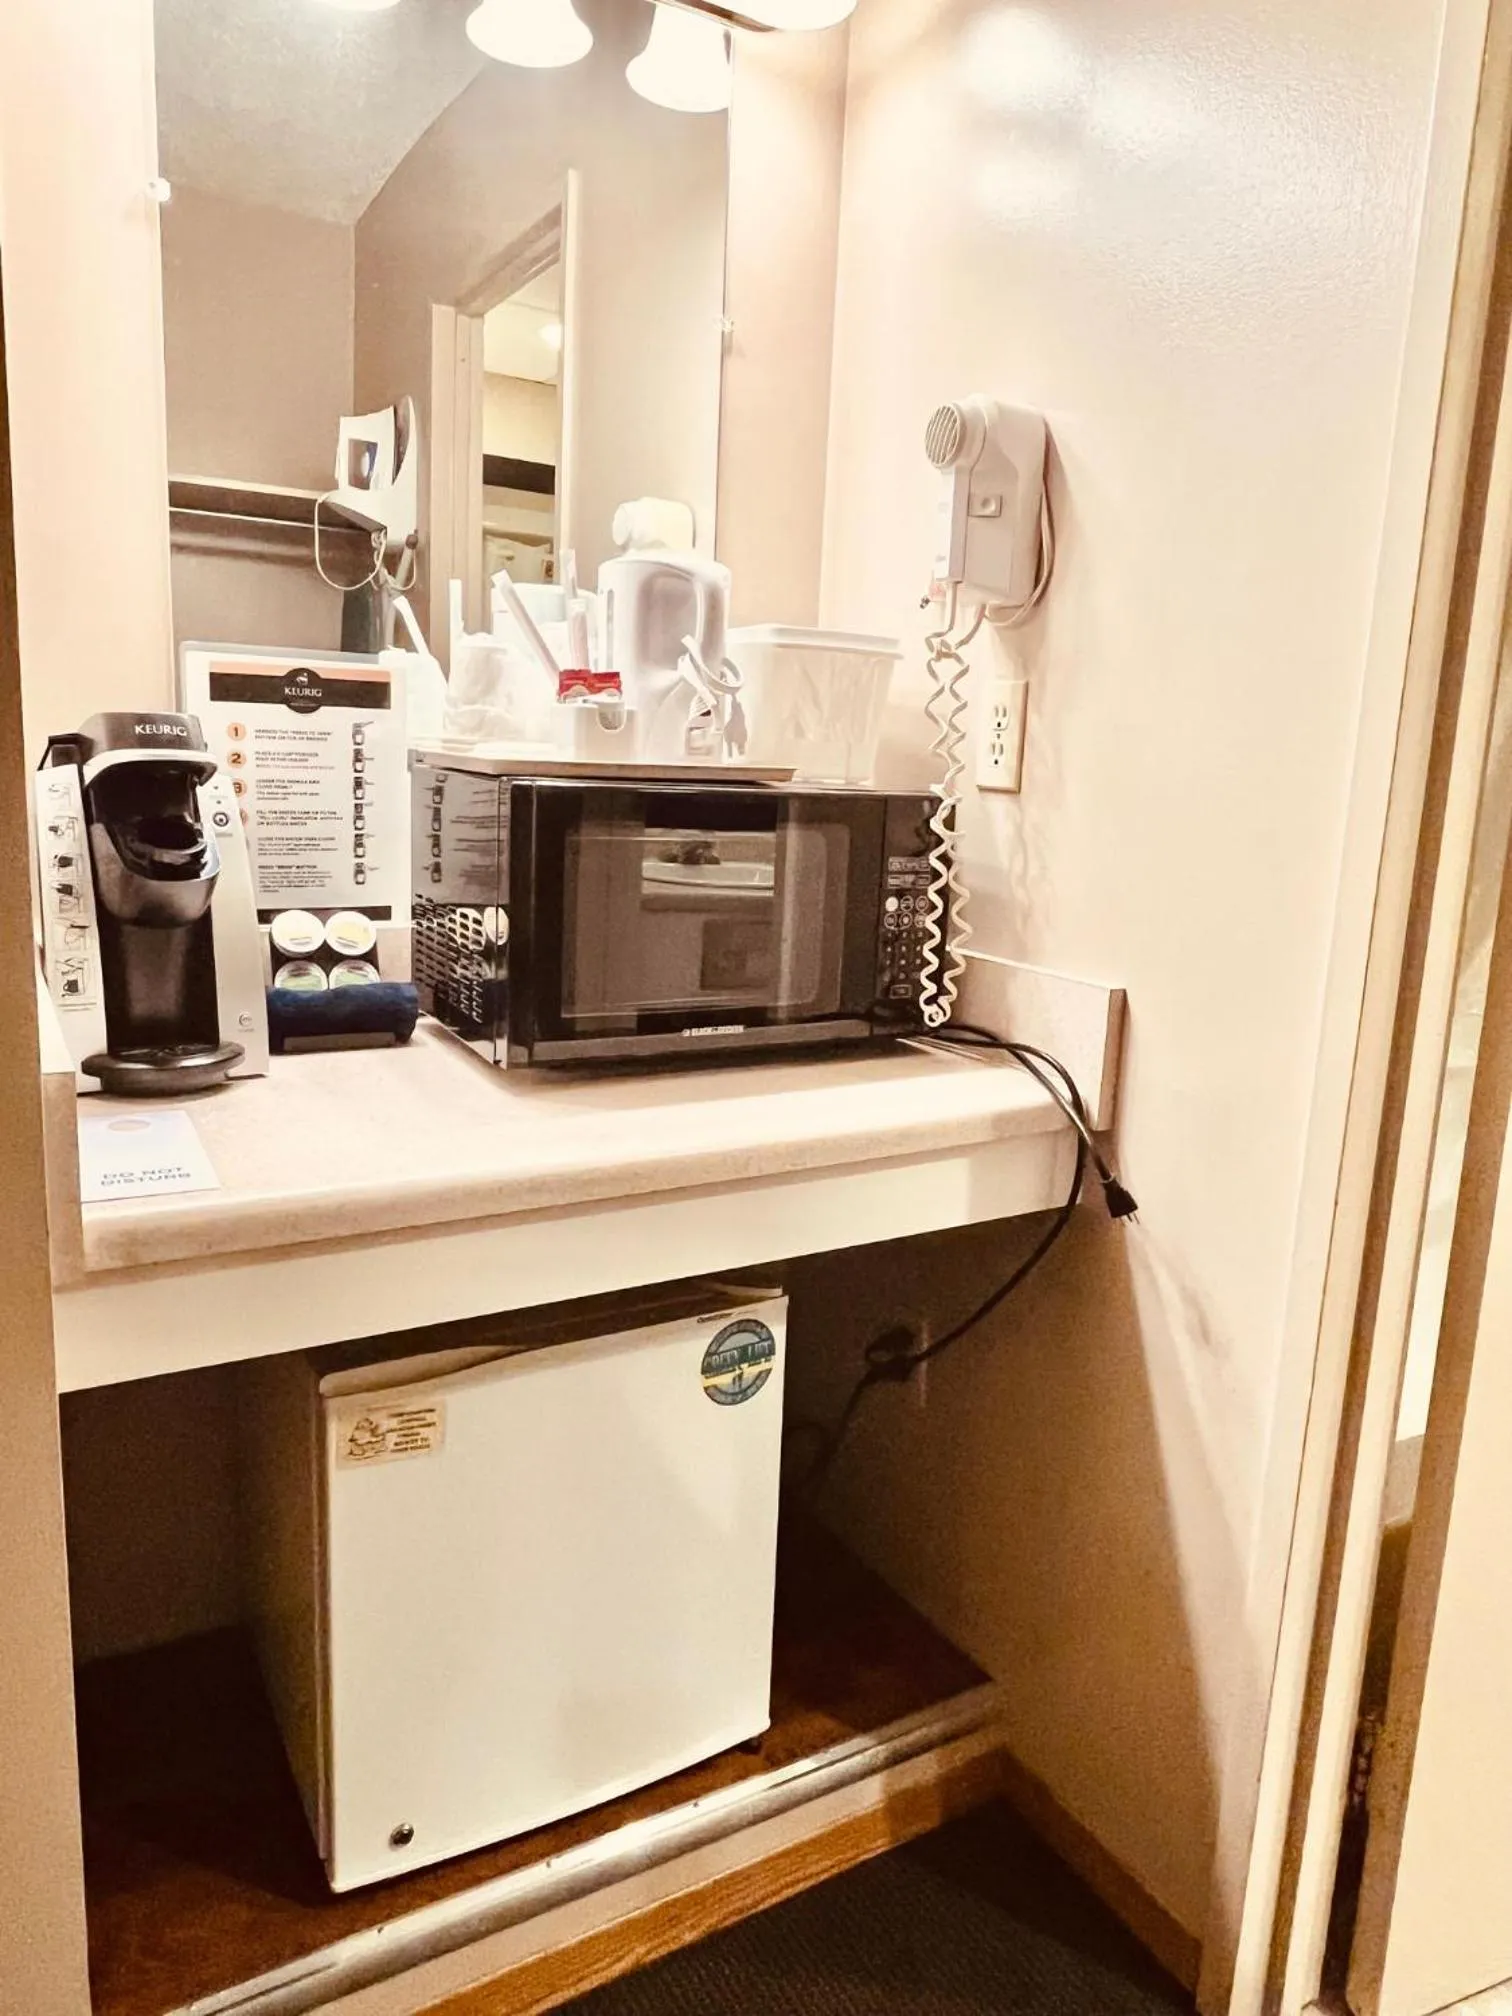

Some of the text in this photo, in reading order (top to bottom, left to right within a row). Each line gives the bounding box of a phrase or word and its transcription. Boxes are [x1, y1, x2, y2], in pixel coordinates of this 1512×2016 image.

[284, 686, 322, 698] KEURIG
[134, 723, 188, 737] KEURIG
[233, 726, 239, 737] 1
[231, 753, 242, 764] 2
[142, 1166, 182, 1176] NOT
